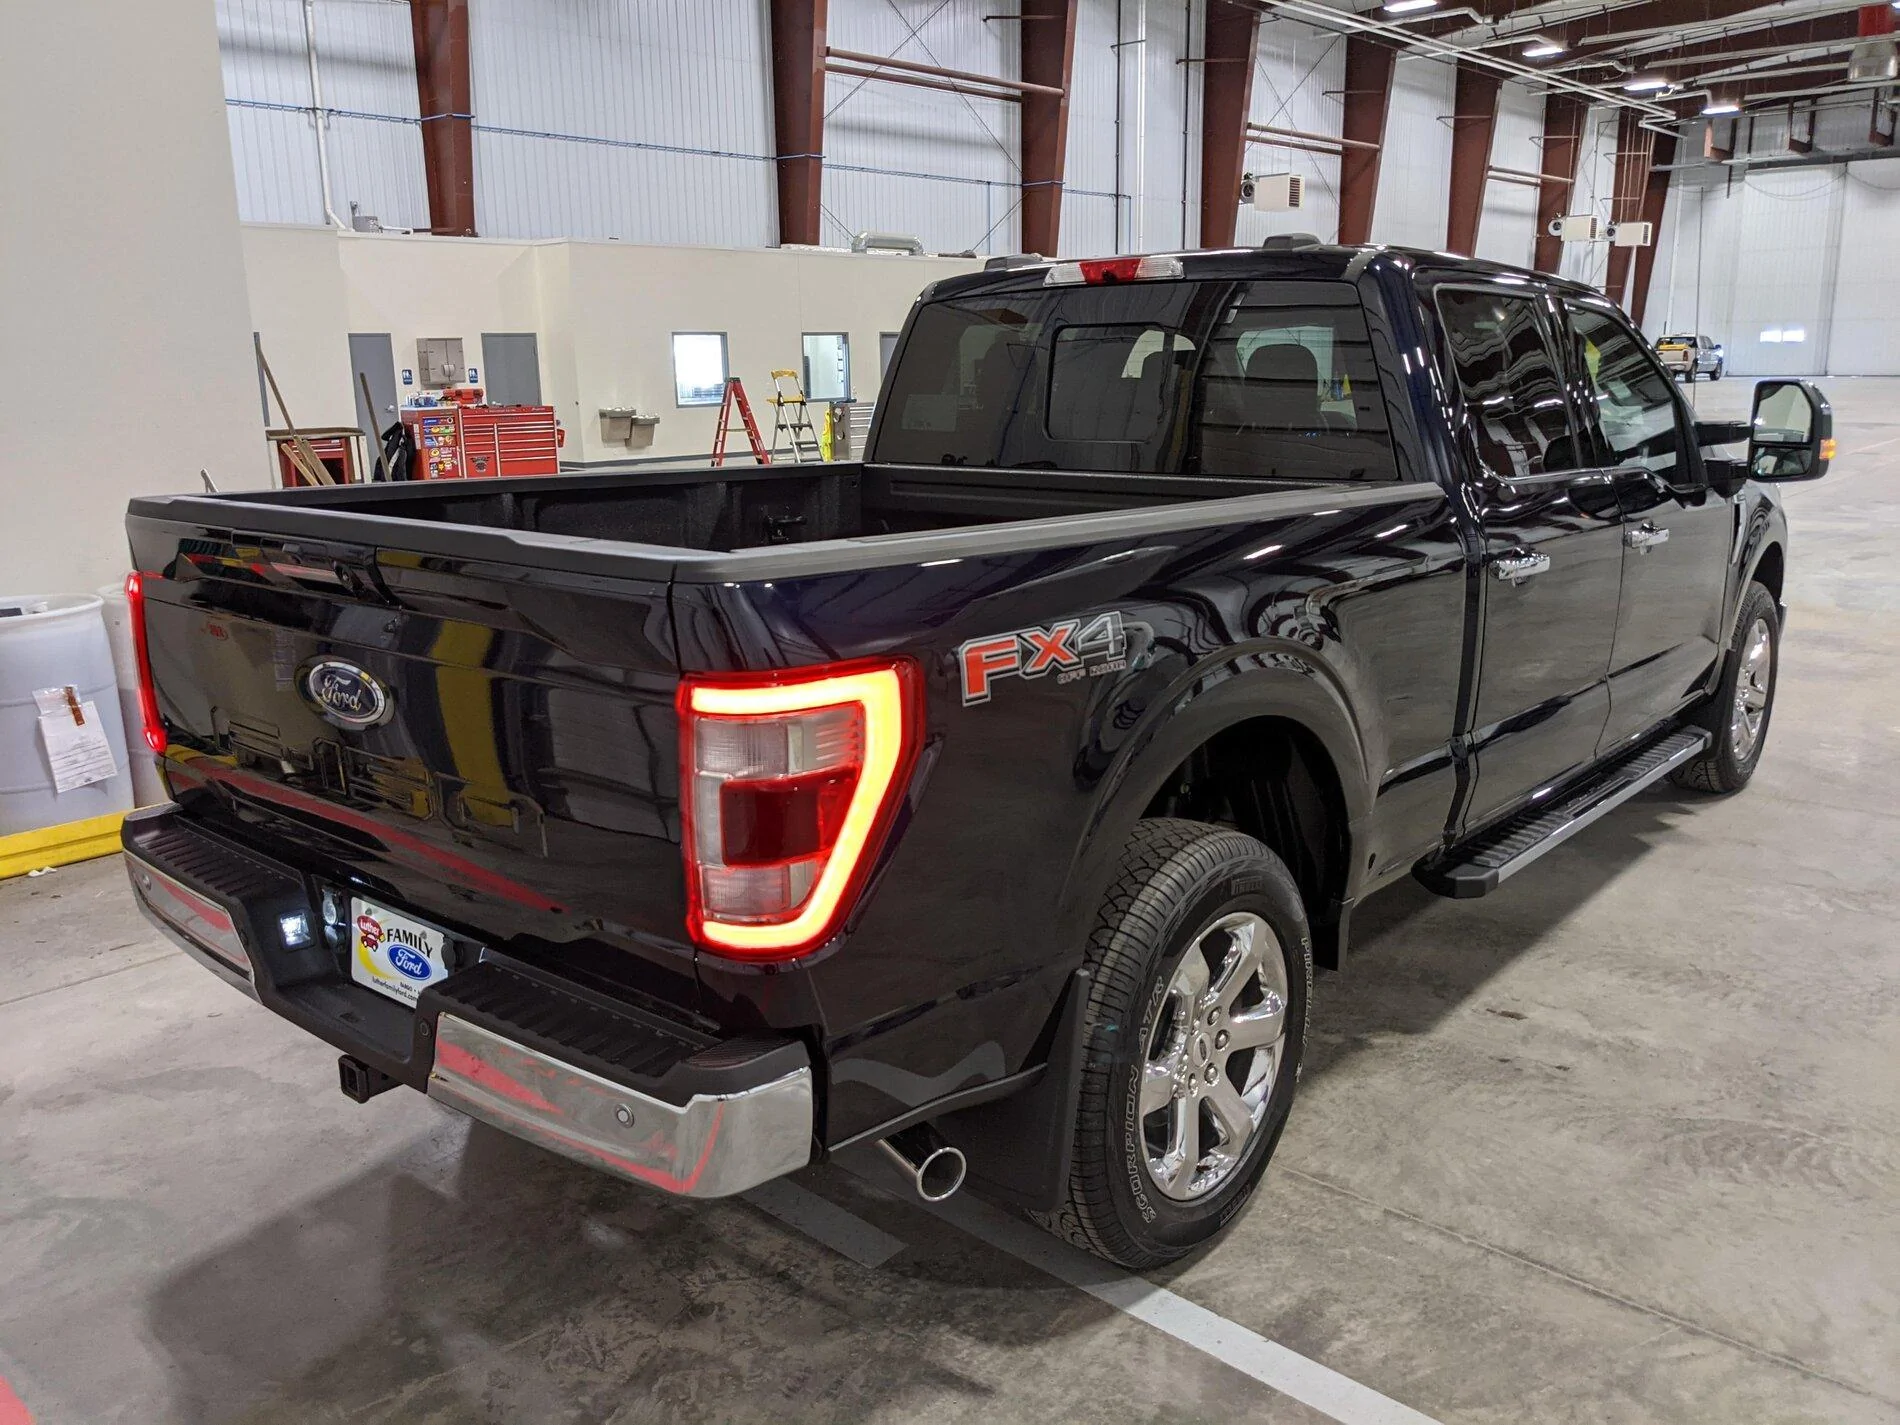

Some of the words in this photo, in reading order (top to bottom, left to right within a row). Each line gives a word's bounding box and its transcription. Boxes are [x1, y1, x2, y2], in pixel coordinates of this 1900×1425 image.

[960, 611, 1127, 707] FX4
[322, 674, 361, 711] Ford
[360, 919, 379, 935] Luther
[387, 929, 432, 958] FAMILY
[395, 949, 422, 975] Ford
[1138, 976, 1163, 1052] ATR
[1125, 1065, 1157, 1224] SCORPION
